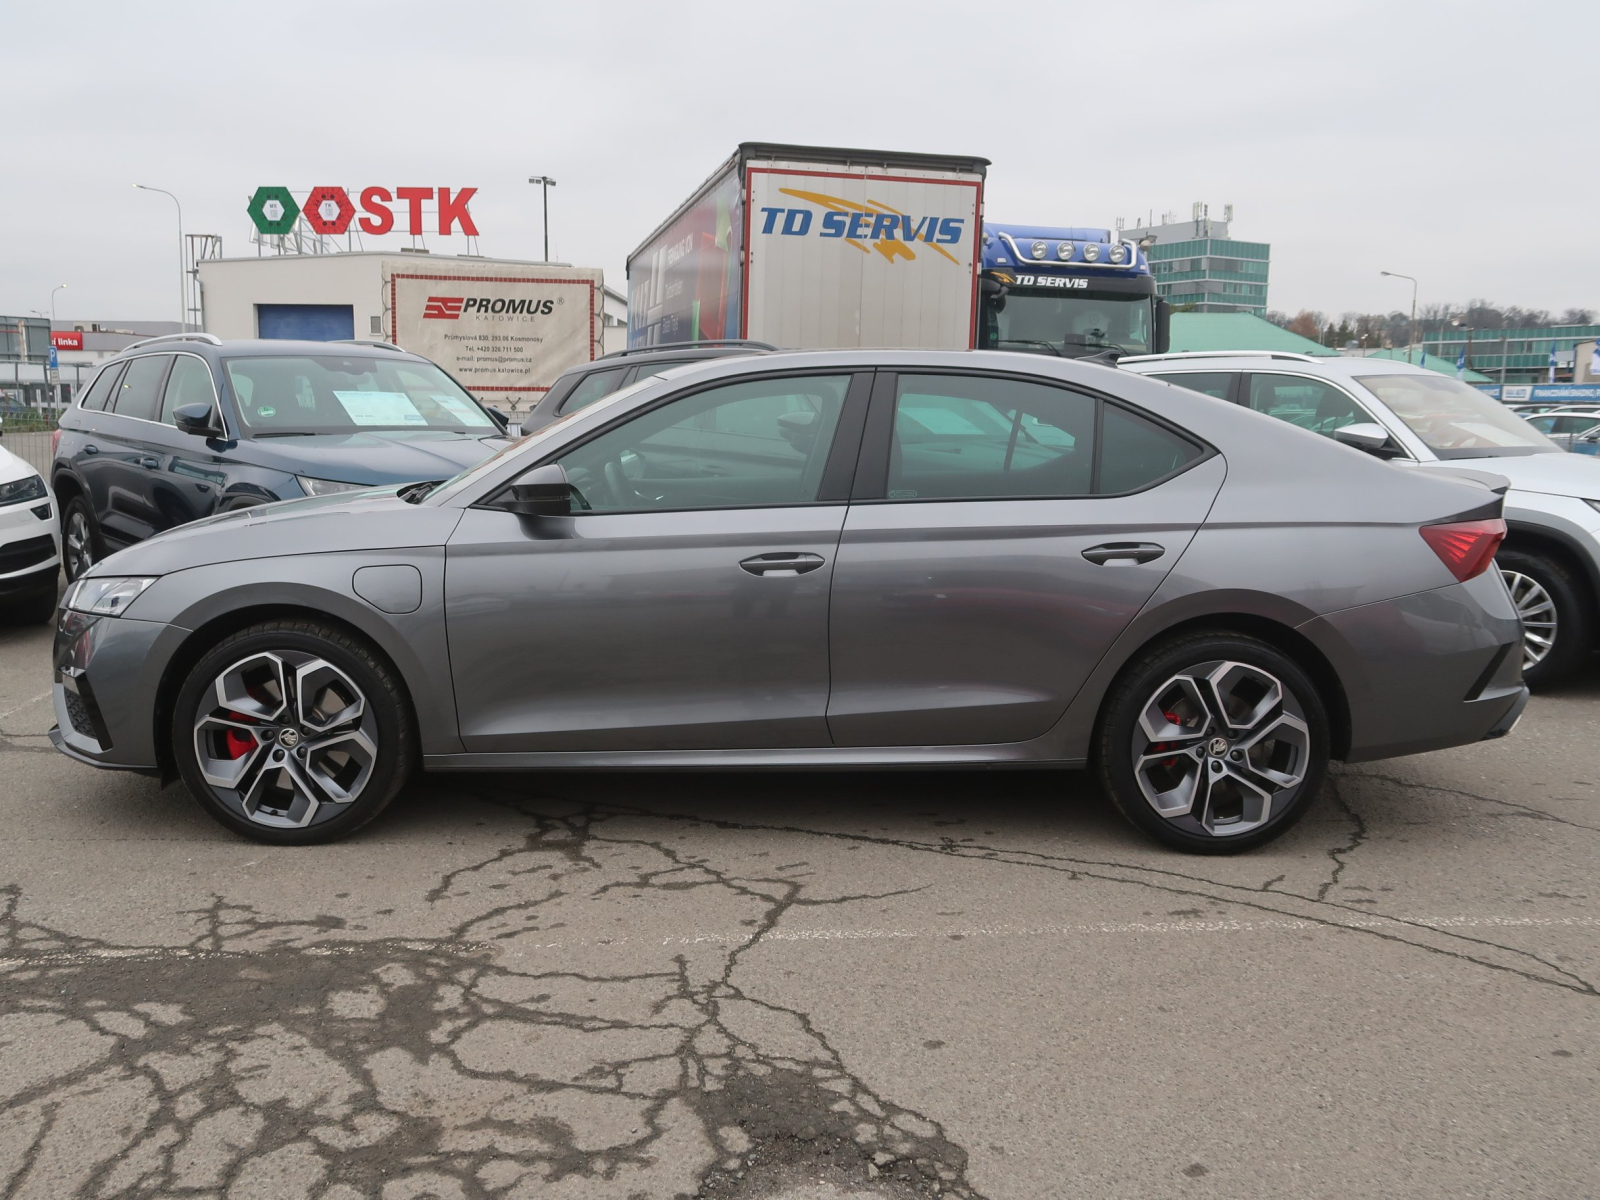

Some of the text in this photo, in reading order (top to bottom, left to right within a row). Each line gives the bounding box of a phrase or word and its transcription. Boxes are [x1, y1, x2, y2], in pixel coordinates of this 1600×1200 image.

[358, 186, 480, 236] STK
[760, 207, 965, 244] TD SERVIS
[1015, 274, 1089, 289] TD SERVIS
[463, 298, 555, 315] PROMUS
[57, 338, 78, 346] linka
[510, 336, 543, 344] Kosmonosy
[50, 349, 56, 362] P
